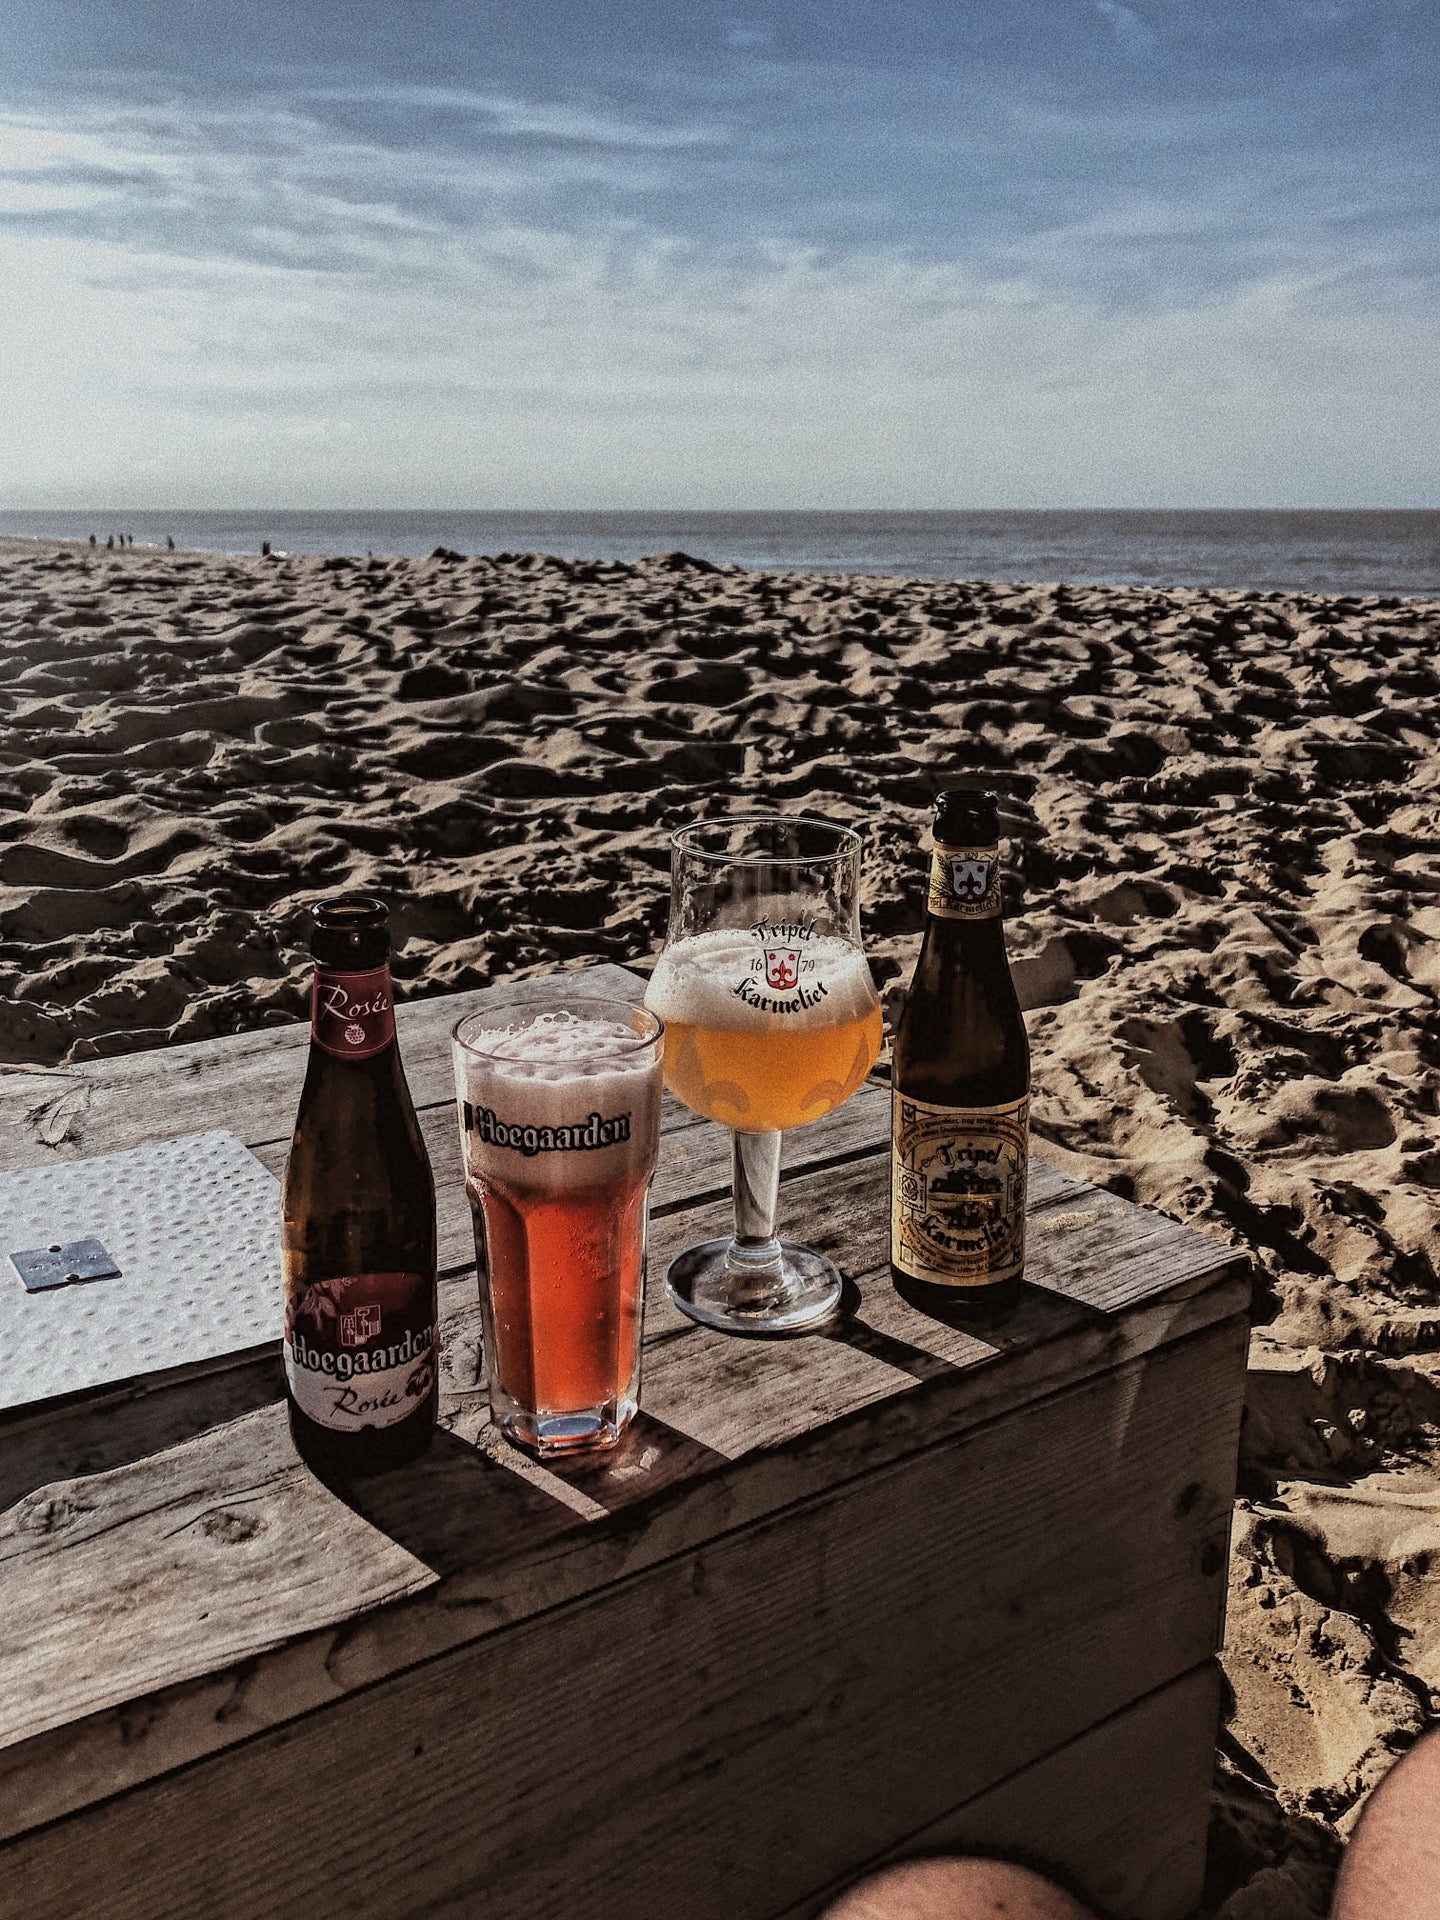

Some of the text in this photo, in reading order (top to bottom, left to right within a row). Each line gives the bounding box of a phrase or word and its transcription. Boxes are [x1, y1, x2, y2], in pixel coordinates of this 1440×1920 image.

[749, 914, 818, 944] Tripel
[750, 958, 815, 972] 16 79
[317, 984, 390, 1021] Rosée
[729, 976, 828, 1014] Karmeliet
[475, 1106, 630, 1157] Hoegaarden
[936, 1138, 1005, 1169] Tripel
[291, 1325, 434, 1382] Hoegaarden
[323, 1386, 402, 1418] Rosée
